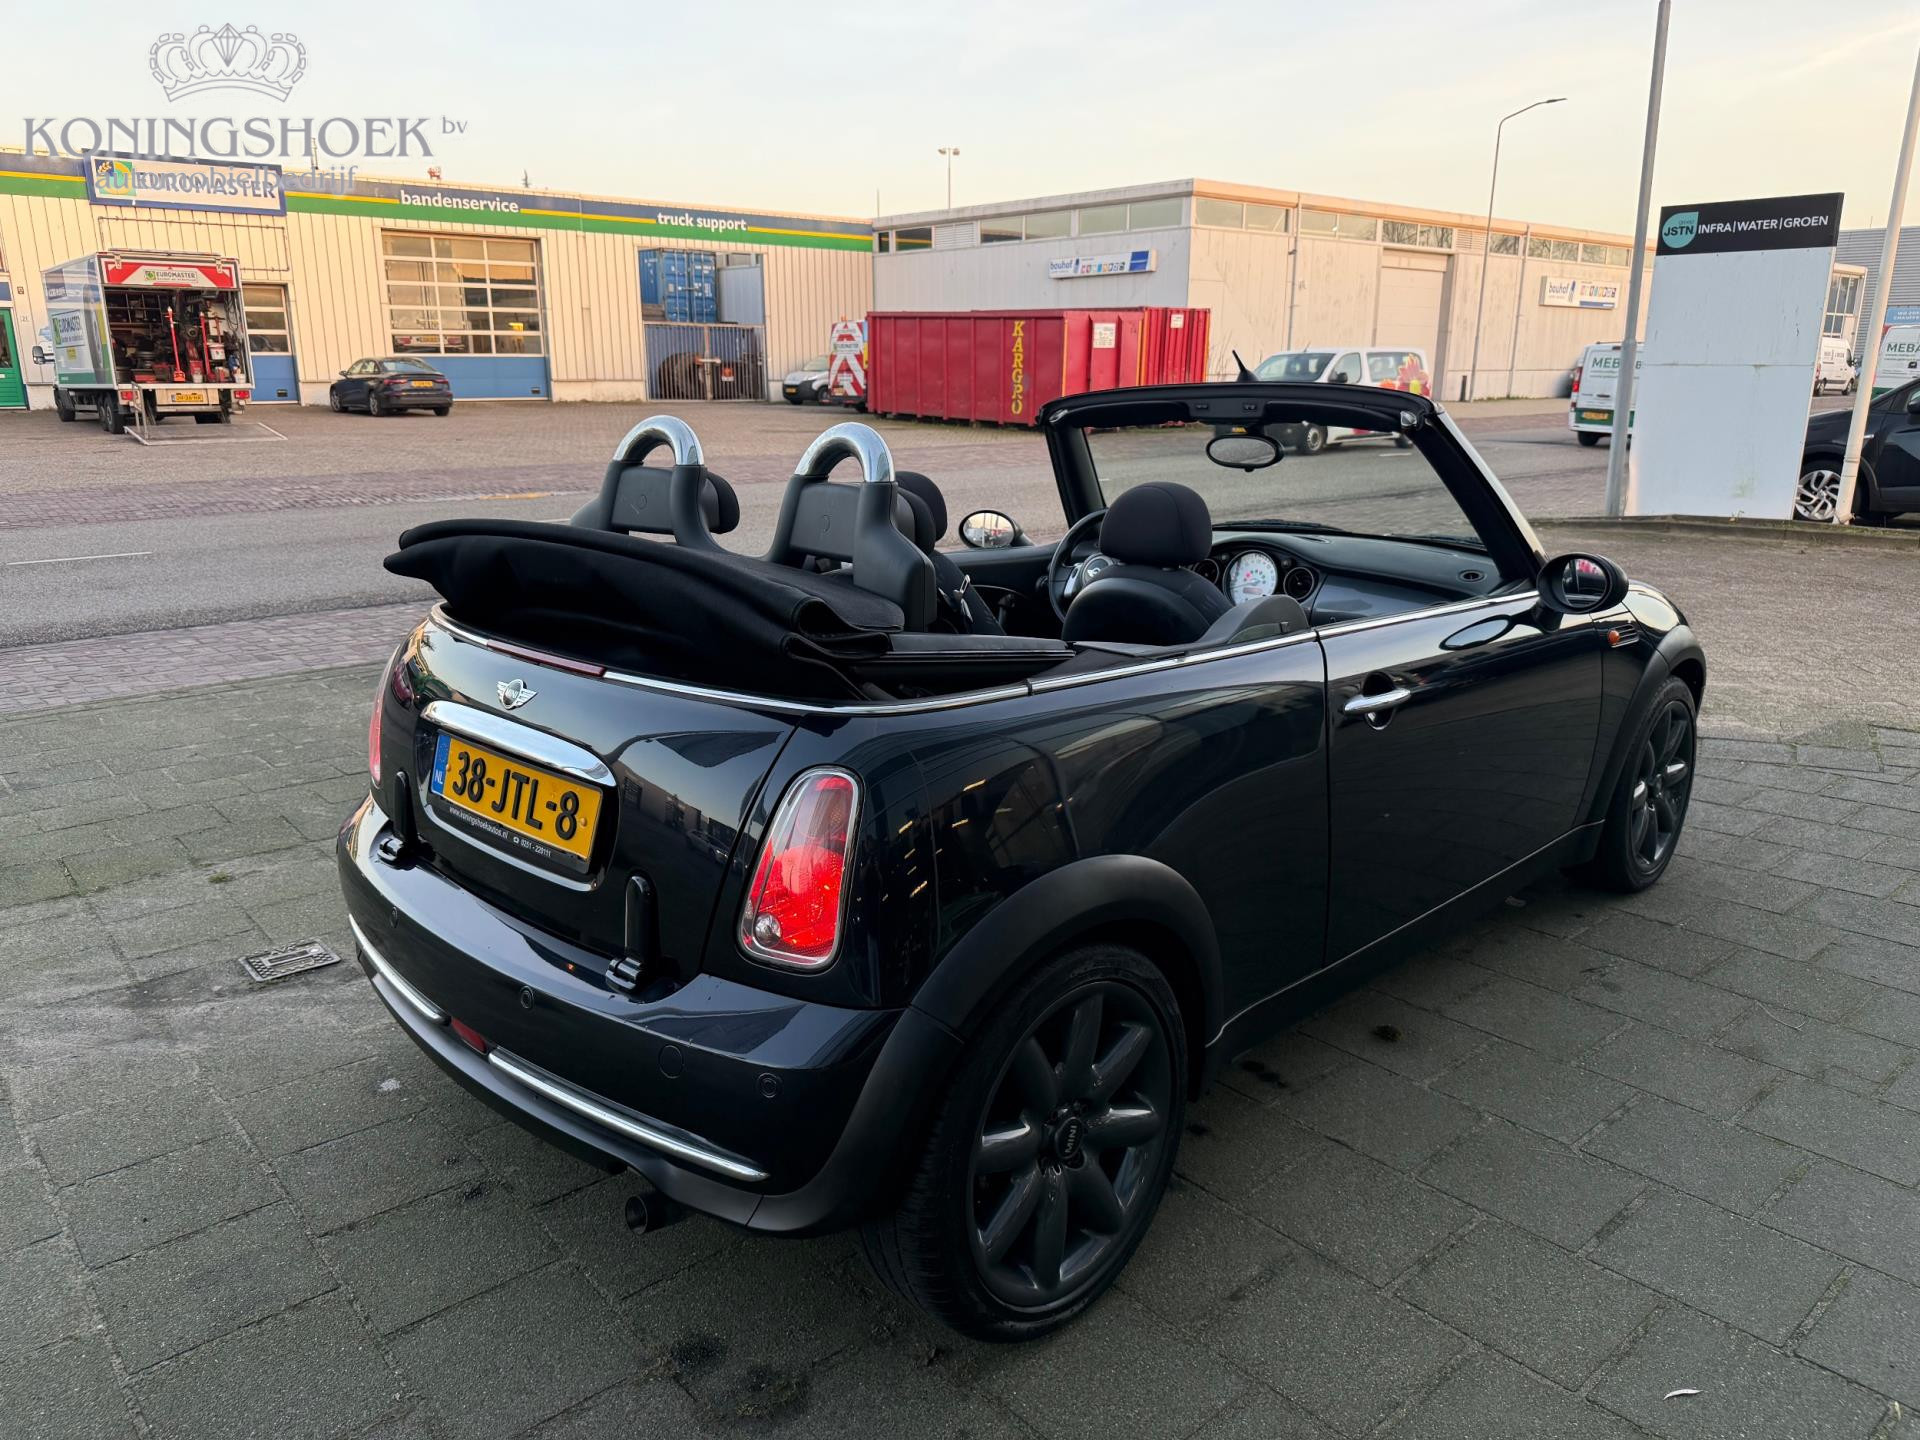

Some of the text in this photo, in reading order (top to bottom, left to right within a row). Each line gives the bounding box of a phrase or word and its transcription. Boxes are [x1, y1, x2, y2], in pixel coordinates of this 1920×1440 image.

[136, 172, 276, 199] EUROMASTER
[400, 189, 519, 213] bandenservice
[657, 212, 746, 233] truck support
[1664, 225, 1694, 237] JSTN
[156, 271, 196, 279] EUROMASTER
[1050, 260, 1073, 270] bauhof
[1549, 282, 1569, 294] bauhof
[1012, 320, 1026, 415] KARGRO
[435, 773, 443, 785] NL
[452, 751, 580, 841] 38-JTL-8
[449, 806, 508, 839] www.koningshoekautos.nl
[1064, 1125, 1077, 1153] MINI
